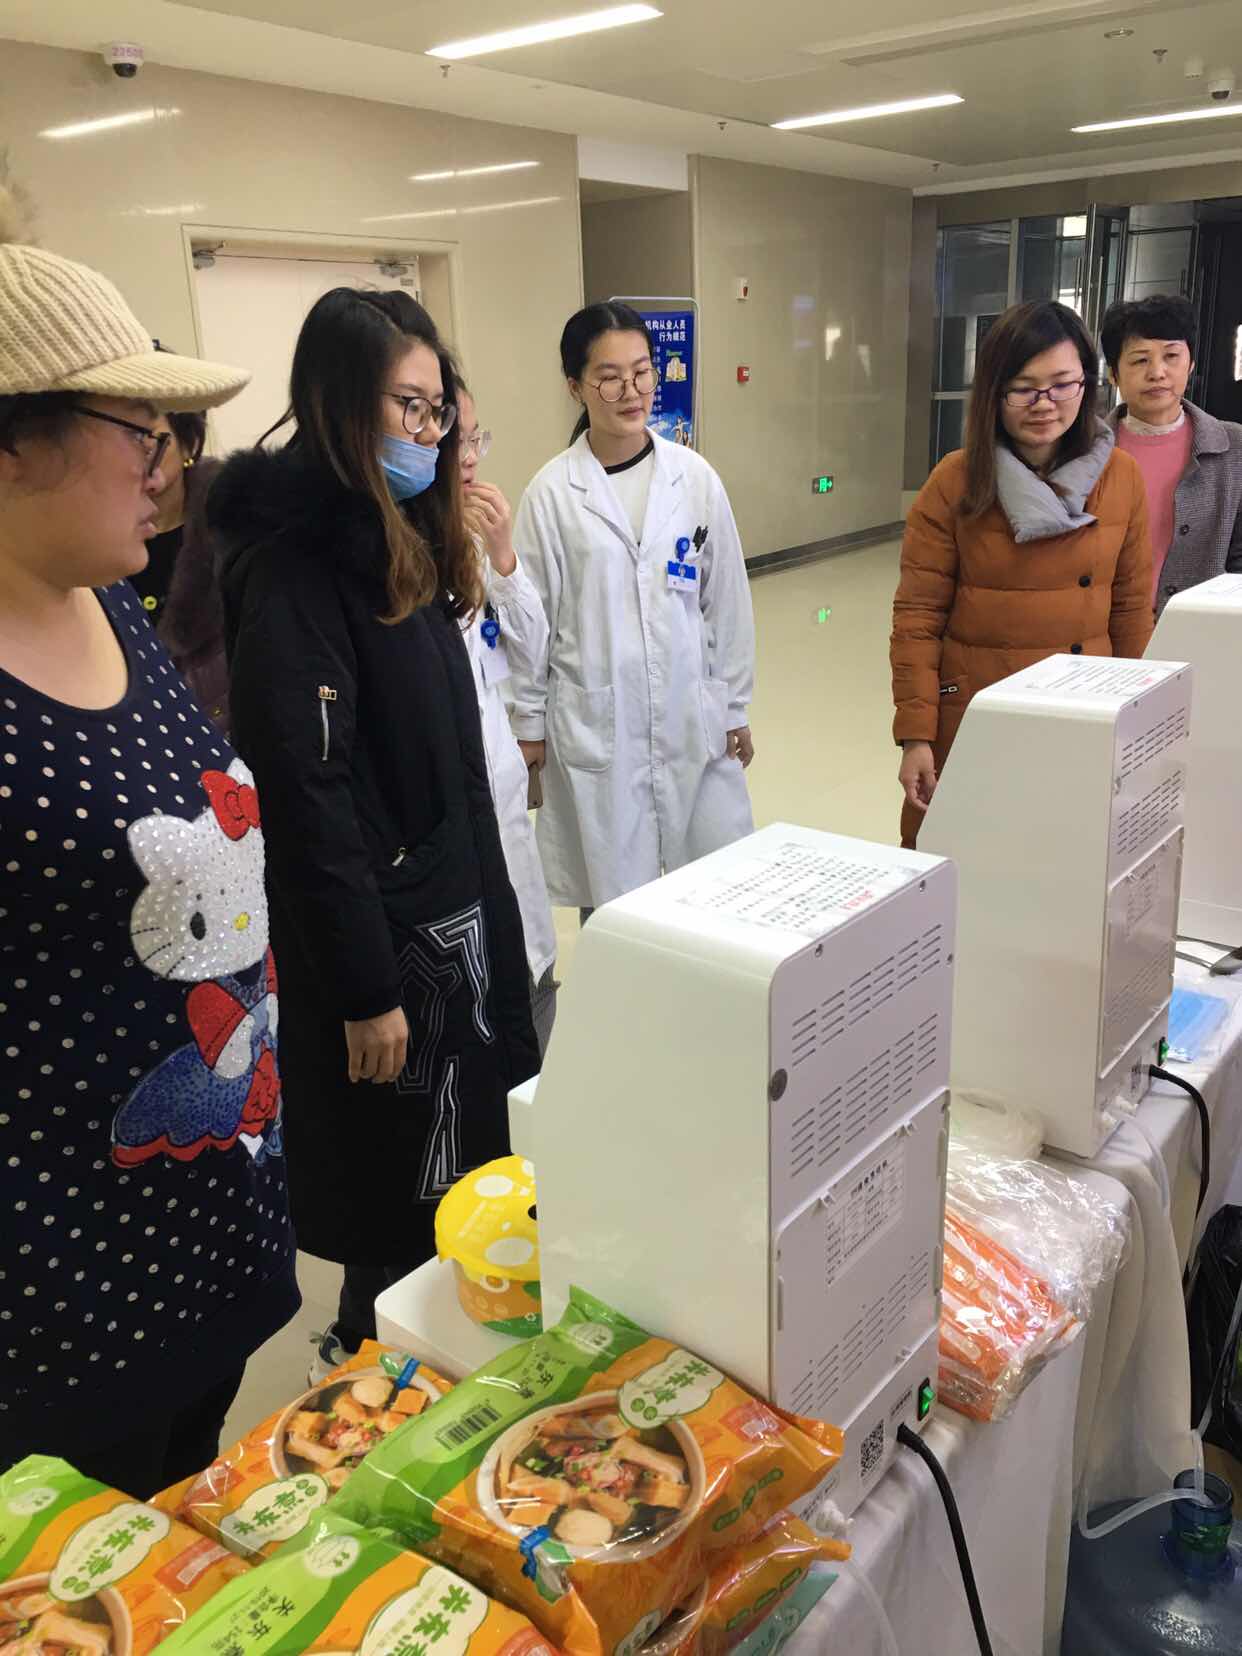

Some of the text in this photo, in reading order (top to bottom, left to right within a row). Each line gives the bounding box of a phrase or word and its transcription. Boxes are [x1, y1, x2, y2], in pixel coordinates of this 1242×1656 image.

[233, 1489, 305, 1534] 关东煮
[78, 1514, 155, 1578] 关东煮
